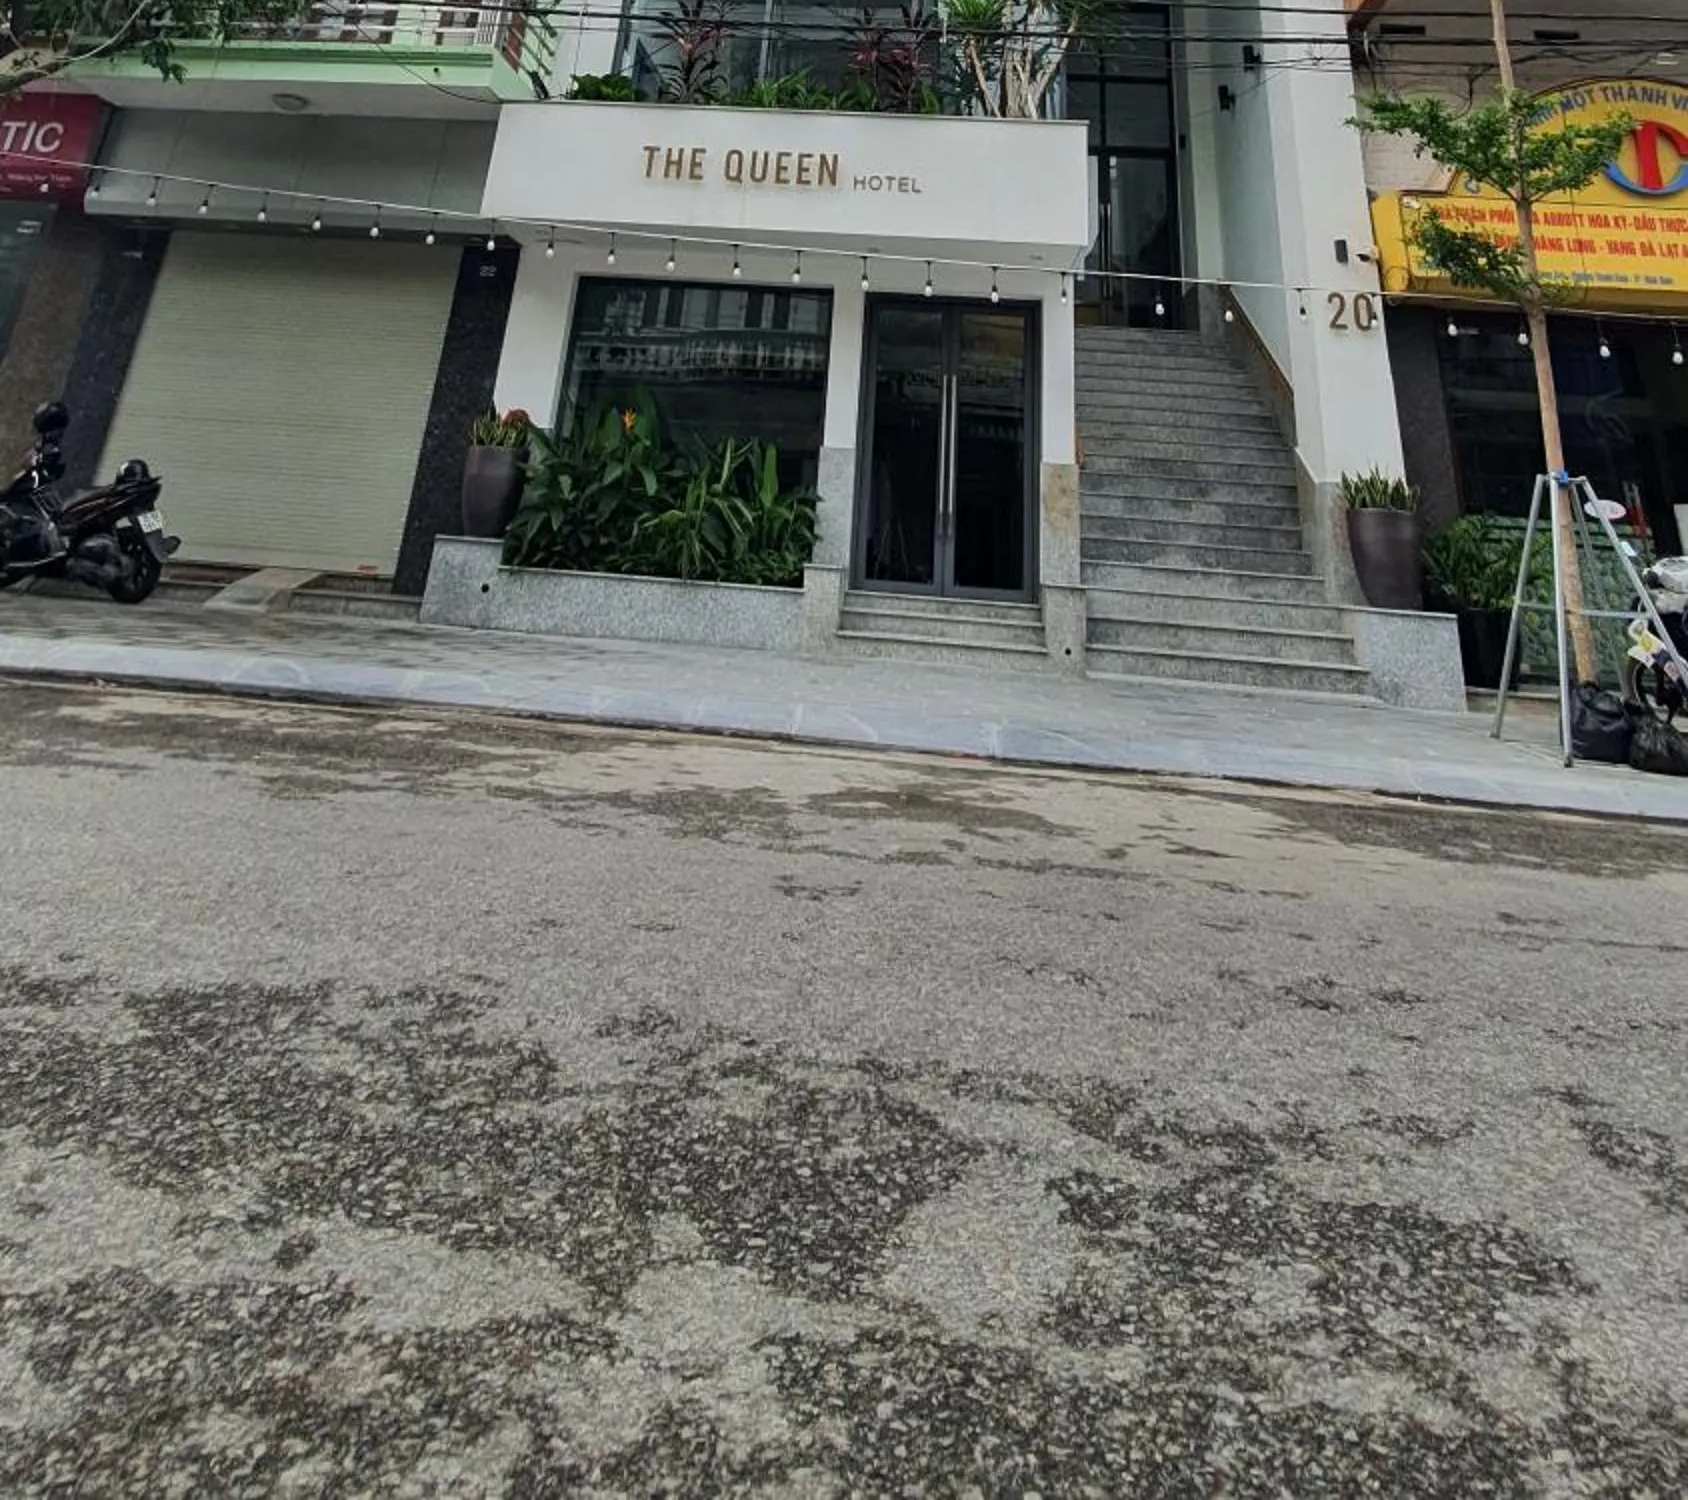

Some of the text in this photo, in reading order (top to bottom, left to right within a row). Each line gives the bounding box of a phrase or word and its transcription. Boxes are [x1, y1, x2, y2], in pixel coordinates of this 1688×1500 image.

[2, 121, 65, 152] TIC
[643, 145, 922, 194] THE QUEEN HOTEL
[1327, 291, 1373, 332] 20
